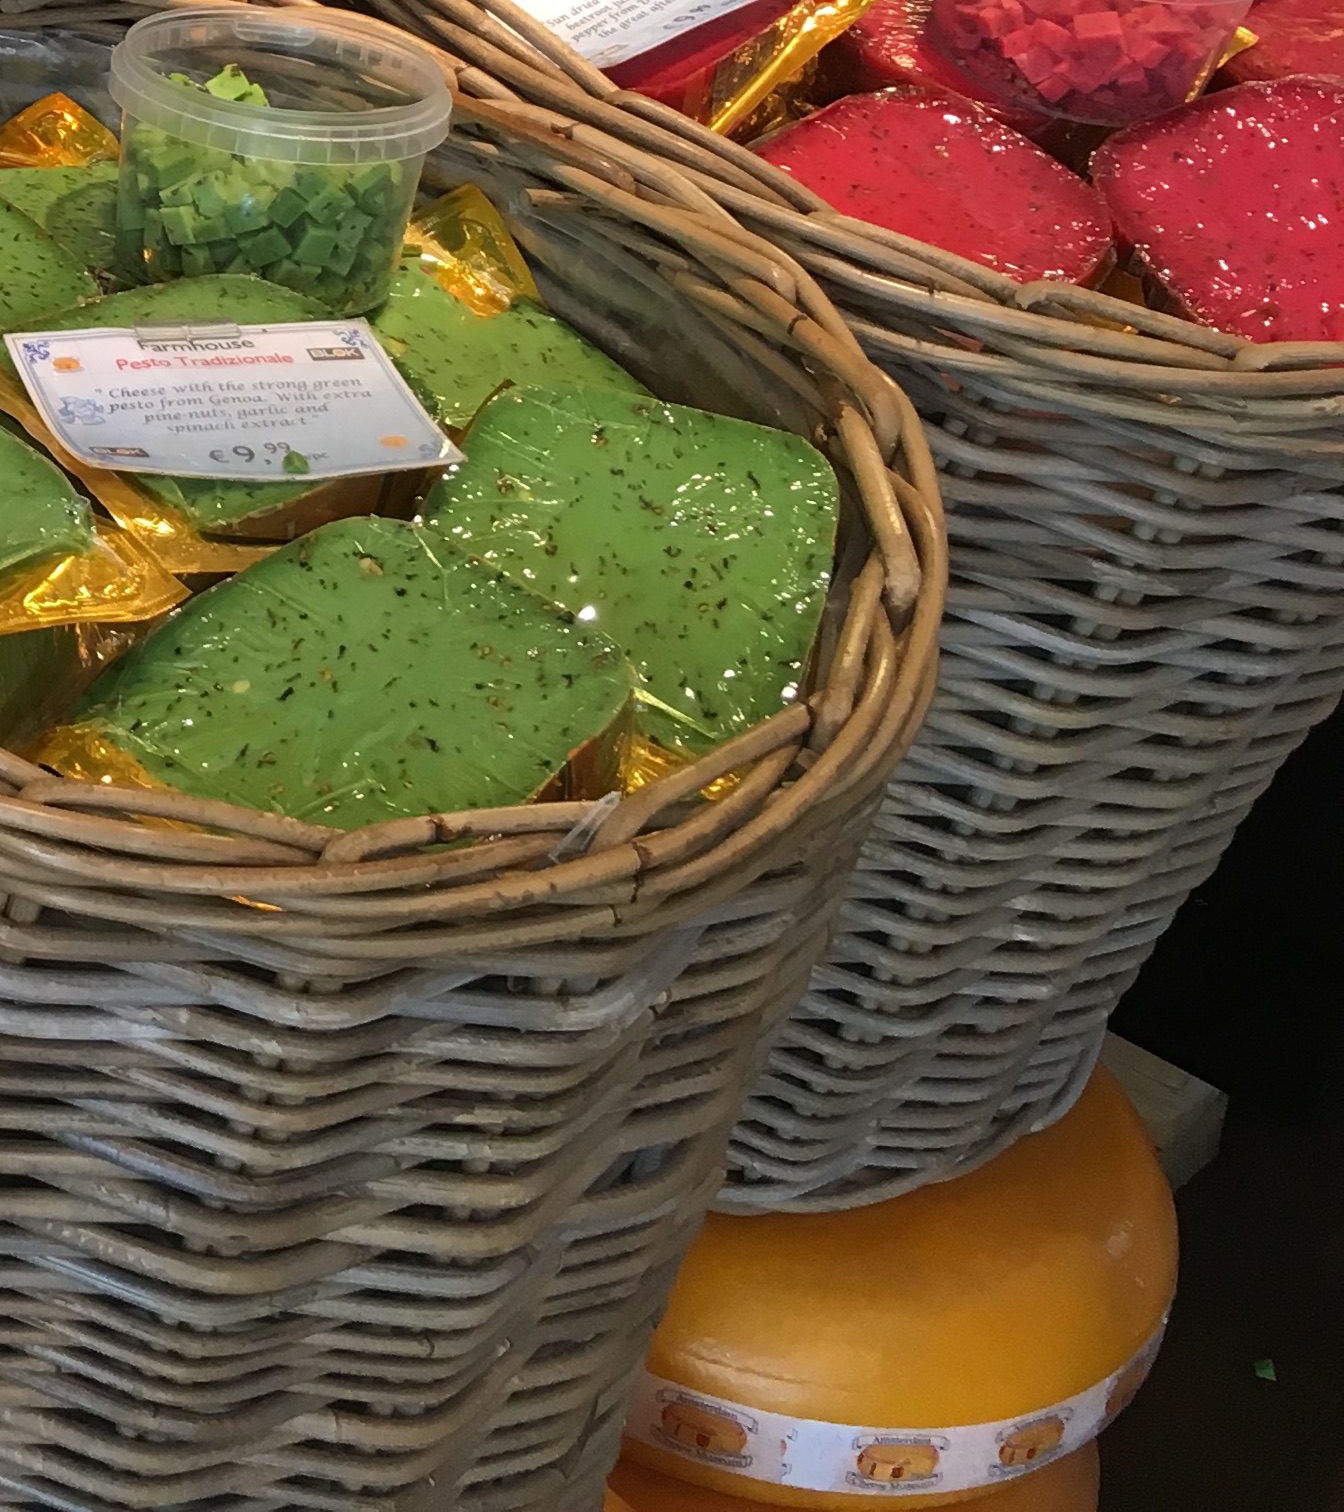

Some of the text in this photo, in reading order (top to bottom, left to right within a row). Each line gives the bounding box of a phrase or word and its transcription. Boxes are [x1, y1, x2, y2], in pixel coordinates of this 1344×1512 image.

[565, 5, 613, 31] beetroot
[570, 19, 609, 43] pepper
[608, 3, 639, 22] from
[597, 27, 617, 39] the
[618, 10, 650, 30] great
[137, 339, 255, 352] Farmhouse
[308, 348, 362, 359] BLOK
[115, 353, 294, 371] Pesto Tradizionale
[108, 386, 166, 399] Cheese
[172, 382, 213, 394] with
[218, 380, 245, 392] the
[251, 379, 308, 392] strong
[313, 378, 362, 392] green
[107, 389, 373, 415] pesto from Genoa. With extra
[237, 405, 288, 420] garlic
[294, 402, 329, 414] and
[166, 421, 236, 434] spinach
